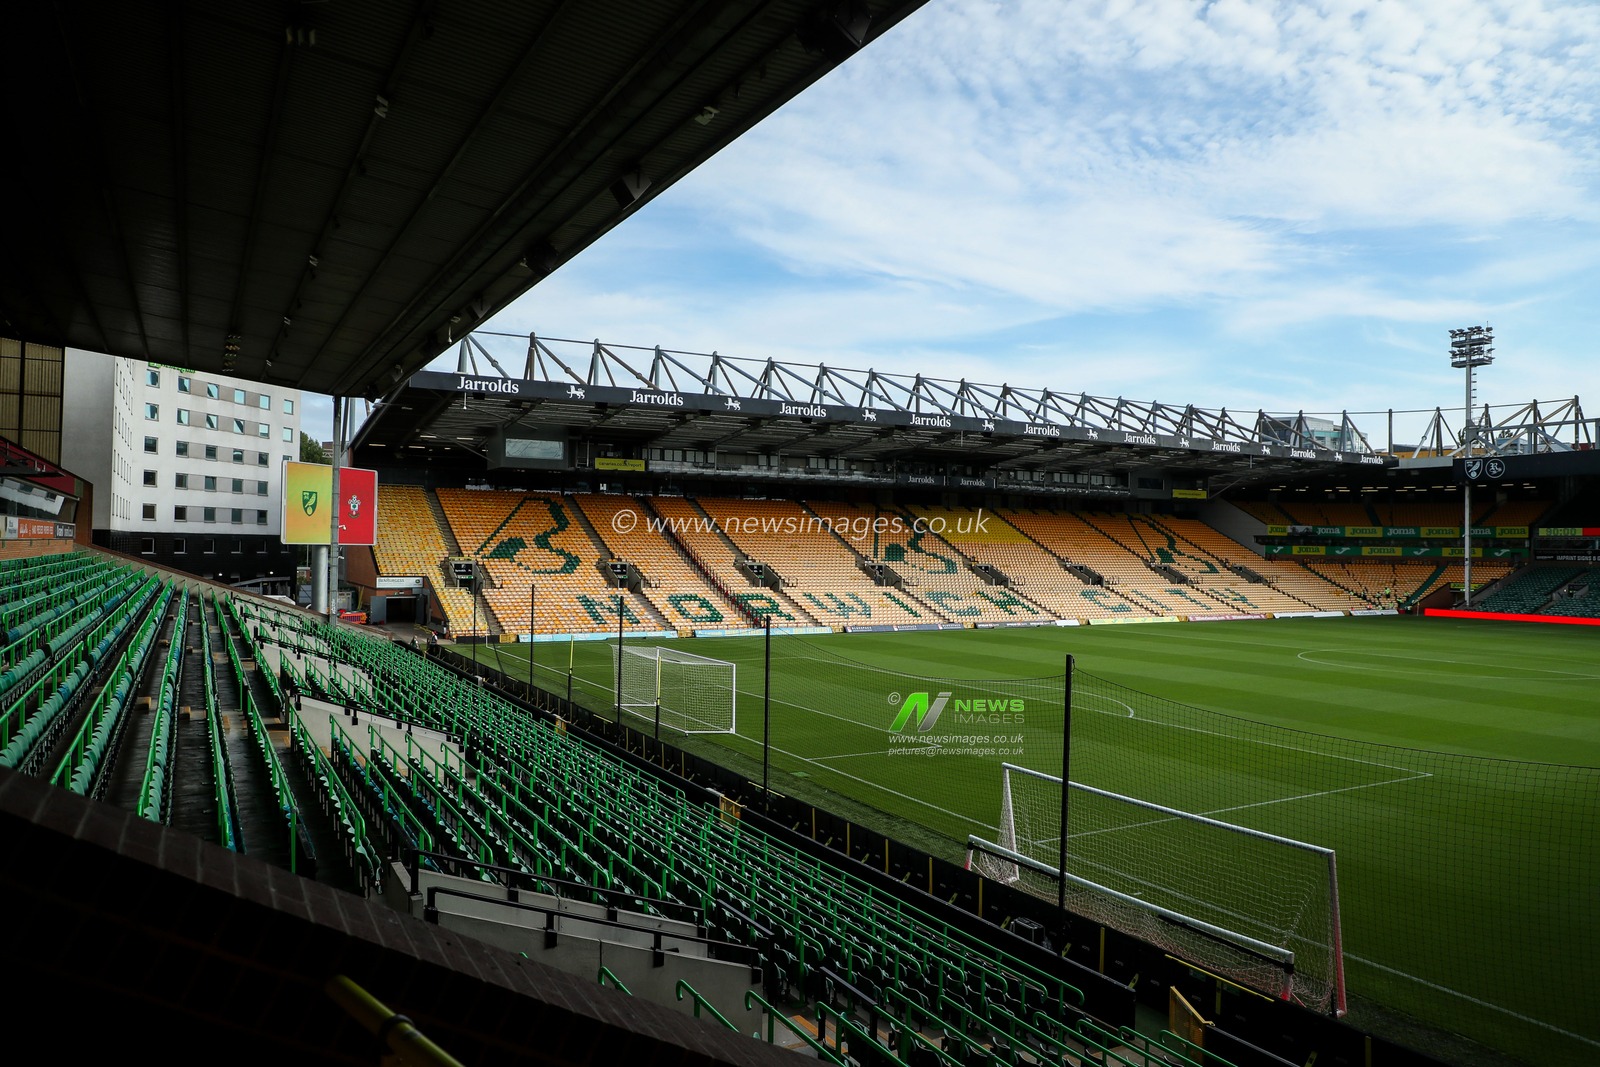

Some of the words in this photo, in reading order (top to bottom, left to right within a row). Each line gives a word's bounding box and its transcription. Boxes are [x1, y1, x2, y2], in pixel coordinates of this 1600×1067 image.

[457, 376, 519, 394] Jarrolds
[630, 390, 684, 408] Jarrolds
[779, 402, 827, 418] Jarrolds
[909, 413, 951, 429] Jarrolds
[1023, 423, 1060, 438] Jarrolds
[1123, 431, 1156, 445] Jarrolds
[1211, 440, 1241, 453] Jarrolds
[1289, 447, 1316, 460] Jarrolds
[1359, 454, 1384, 465] Jarrolds
[907, 475, 935, 484] Jarrolds
[960, 478, 985, 487] Jarrolds
[1470, 527, 1492, 536] oma
